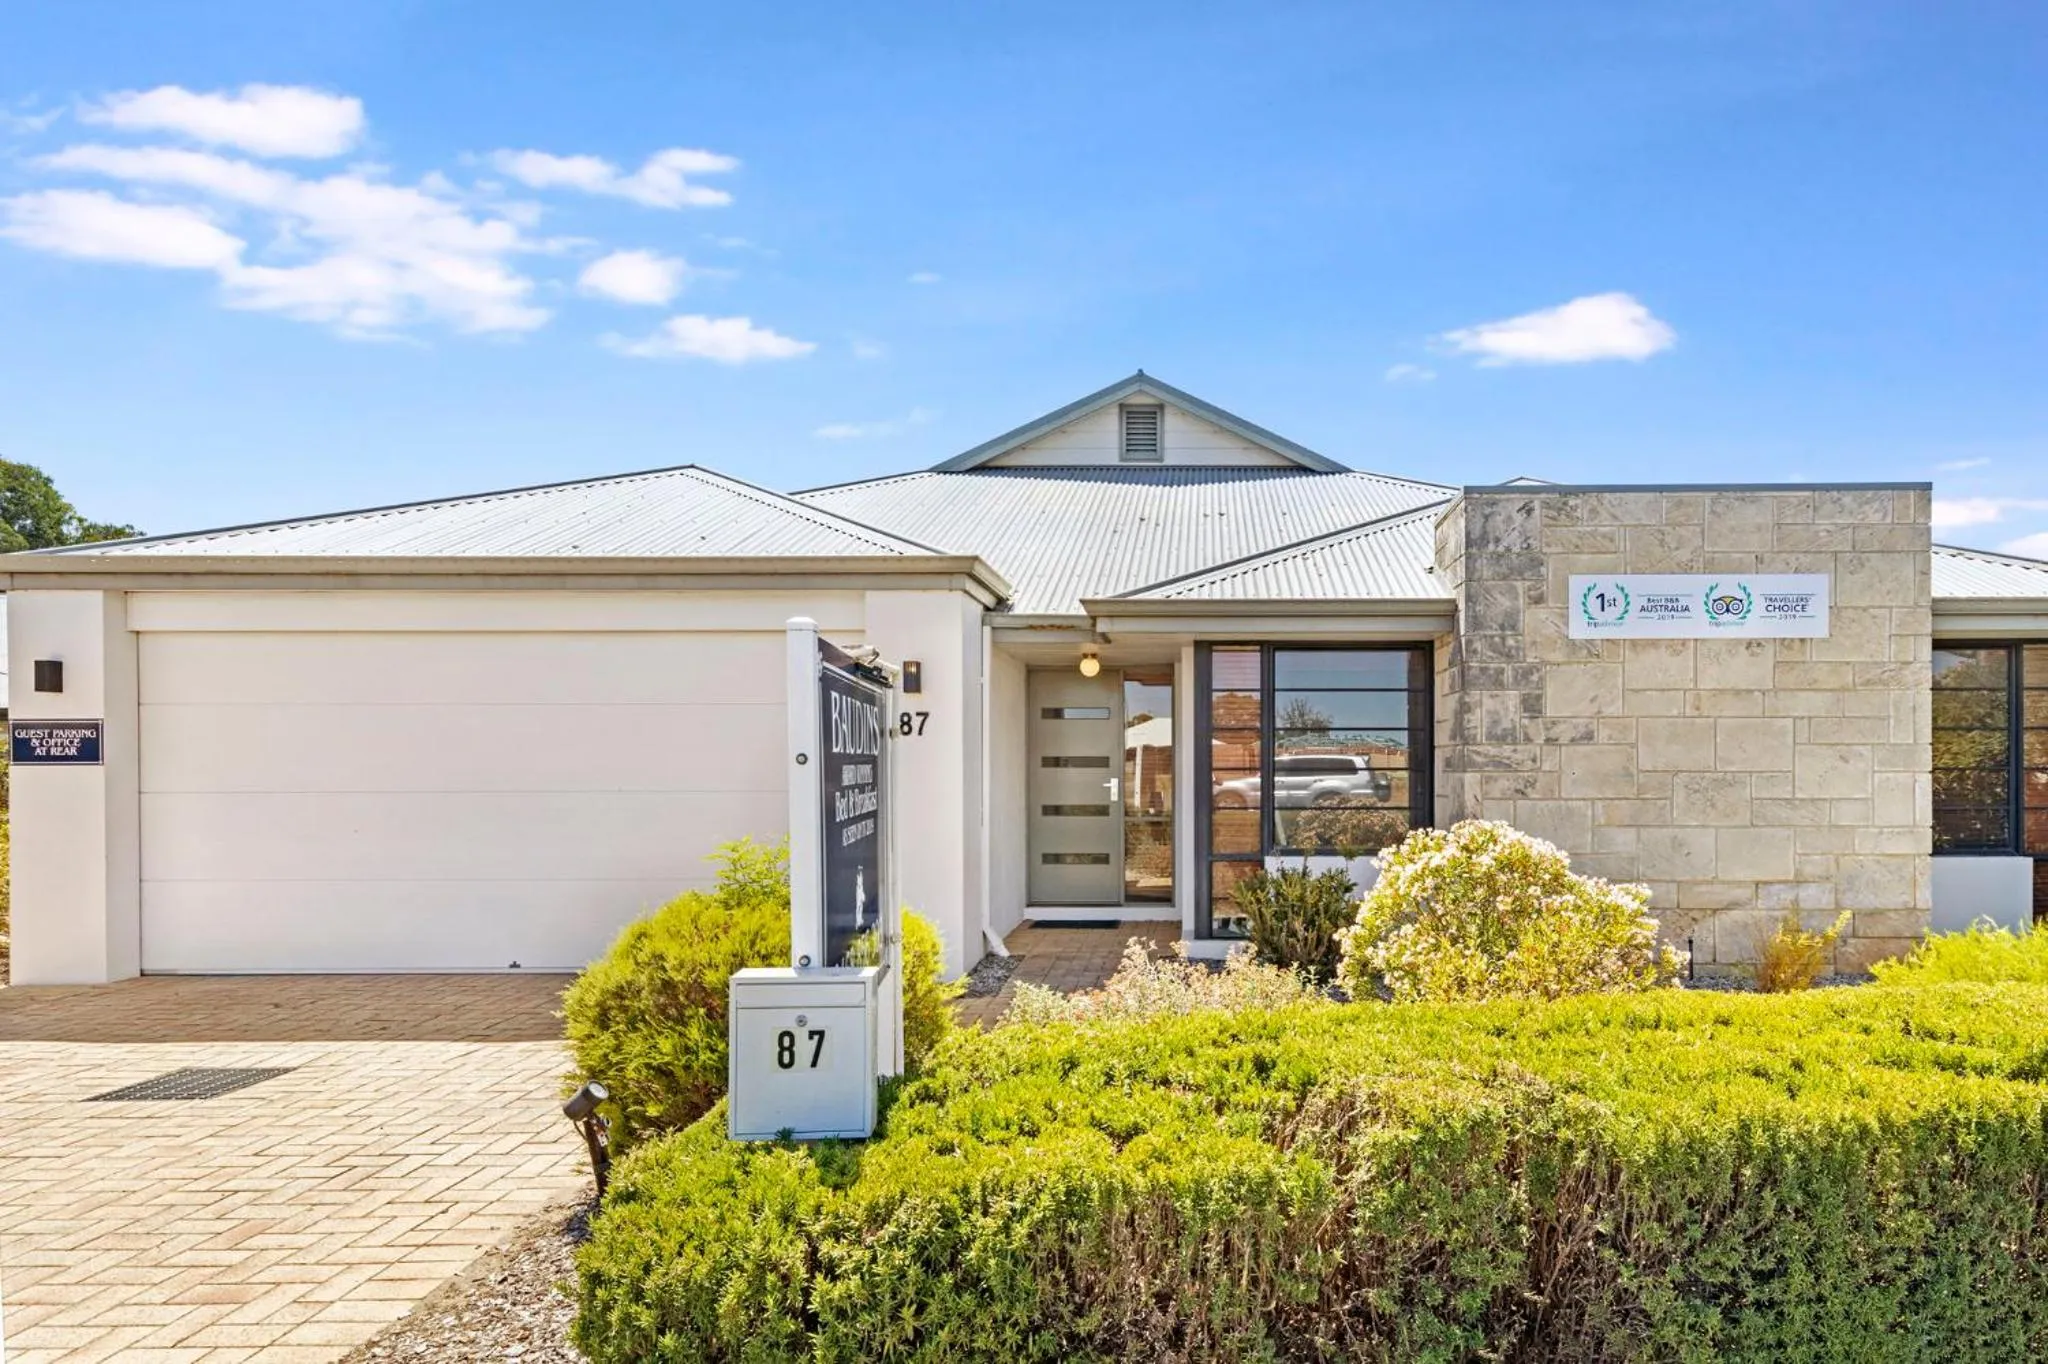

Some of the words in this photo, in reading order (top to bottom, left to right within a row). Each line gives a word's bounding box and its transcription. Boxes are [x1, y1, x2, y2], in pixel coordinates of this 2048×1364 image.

[1595, 592, 1617, 612] 1st
[1639, 604, 1691, 613] AUSTRALIA
[1765, 604, 1807, 613] CHOICE
[830, 690, 880, 756] BAUDINS
[900, 711, 930, 736] 87
[14, 728, 51, 738] GUEST
[52, 728, 96, 738] PARKING
[30, 738, 40, 747] &
[42, 738, 81, 747] OFFICE
[34, 746, 47, 755] AT
[49, 746, 78, 755] REAR
[777, 1029, 826, 1070] 87
